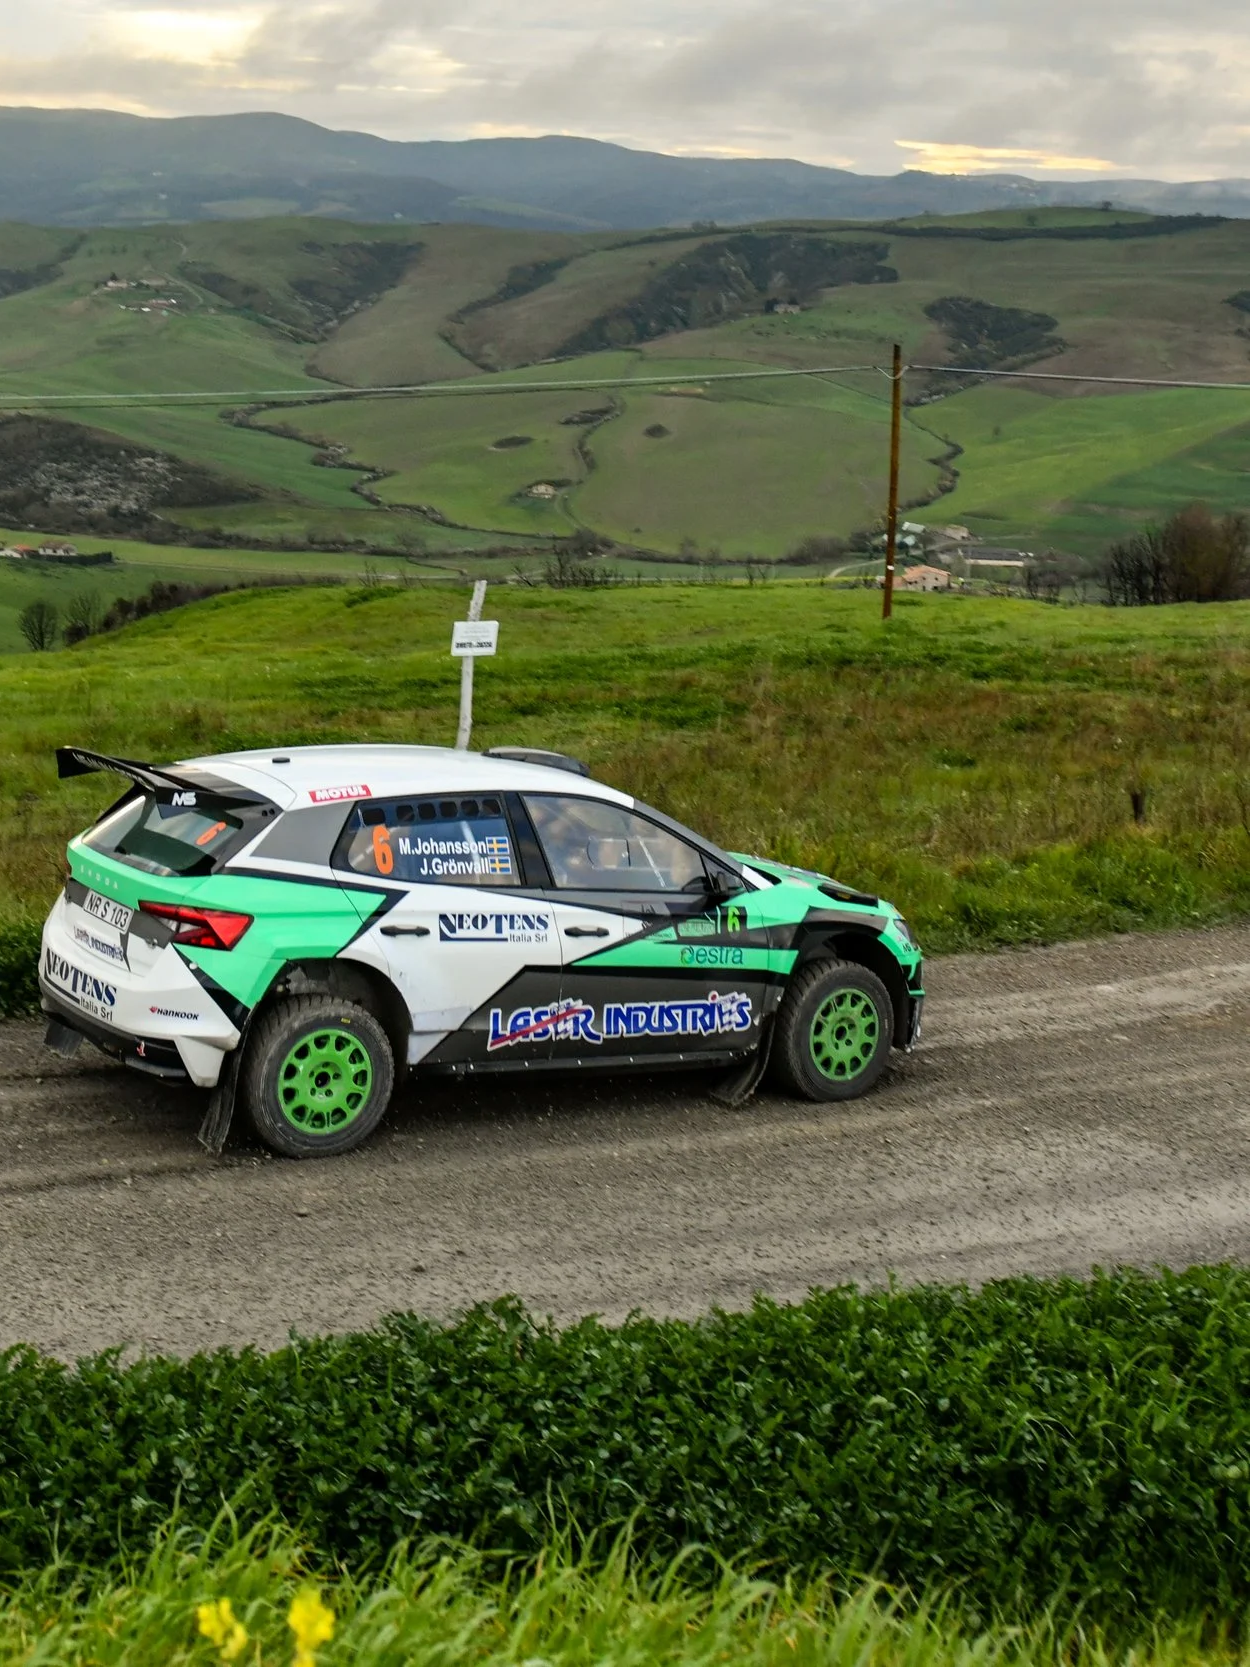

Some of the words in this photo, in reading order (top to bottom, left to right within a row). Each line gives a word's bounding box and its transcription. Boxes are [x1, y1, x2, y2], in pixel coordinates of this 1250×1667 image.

[171, 791, 197, 806] MS
[315, 785, 367, 801] MOTUL
[372, 824, 394, 875] 6
[398, 837, 488, 856] M.Johansson
[420, 856, 490, 876] J.Grönvall
[87, 893, 102, 914] NR
[101, 901, 110, 918] S
[110, 906, 129, 928] 103
[439, 913, 549, 935] NEOTENS
[727, 906, 741, 938] 6
[509, 933, 532, 943] Italia
[535, 933, 548, 943] Srl
[695, 946, 743, 965] estra
[45, 947, 117, 1007] NEOTENS
[79, 996, 99, 1014] Italia
[100, 1007, 114, 1022] Srl
[488, 998, 603, 1050] LASER
[602, 990, 752, 1038] INDUSTRIES
